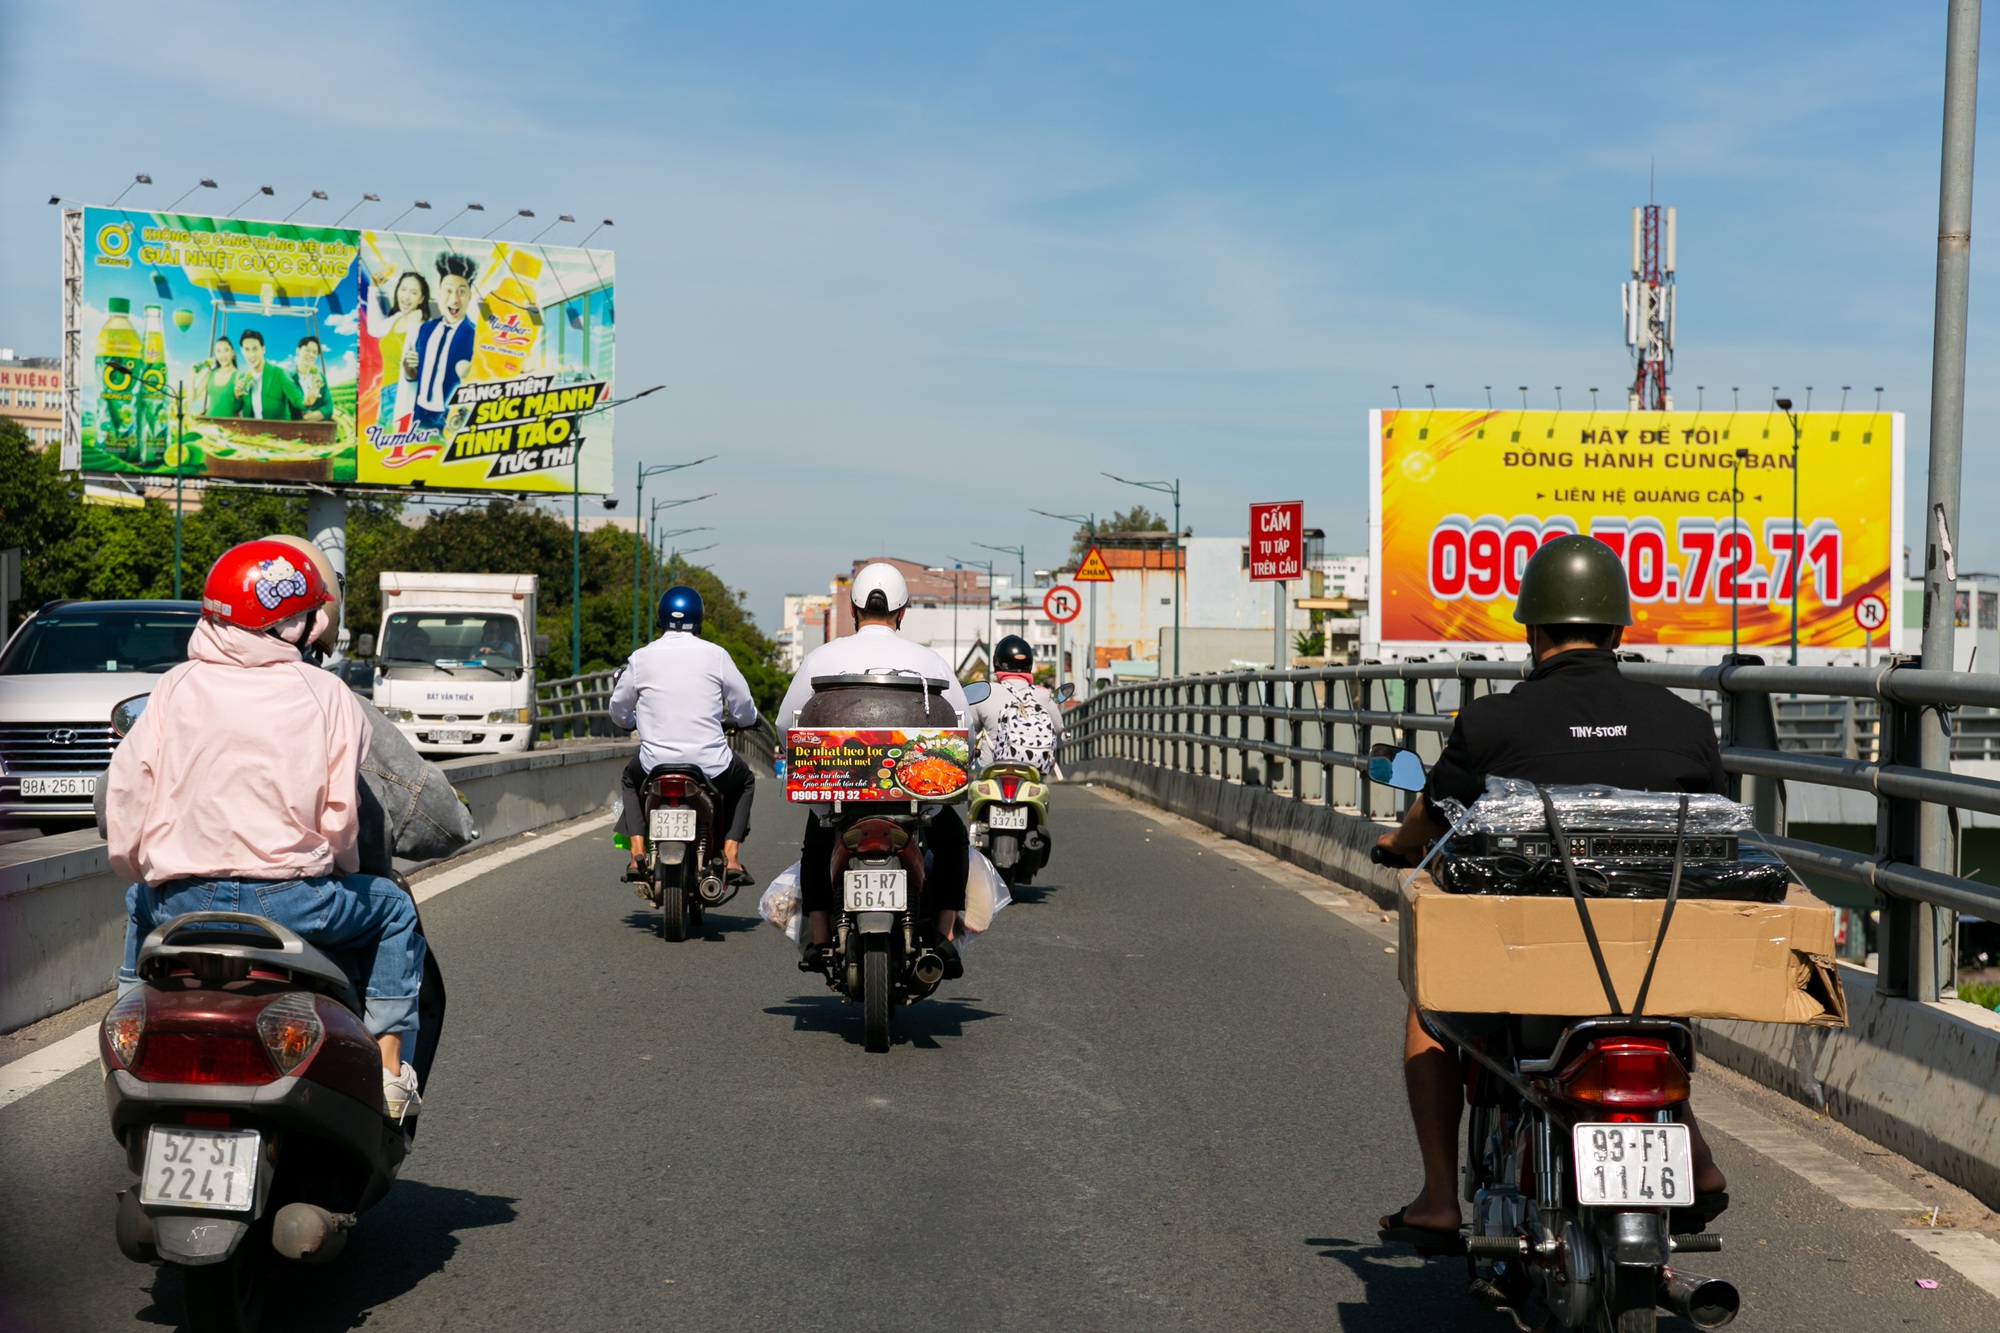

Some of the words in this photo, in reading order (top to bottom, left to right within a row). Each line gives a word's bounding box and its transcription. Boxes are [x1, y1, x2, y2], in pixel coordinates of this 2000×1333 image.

[143, 227, 190, 243] KHÔNG
[213, 231, 250, 249] CĂNG
[254, 232, 295, 253] THẲNG
[323, 240, 348, 256] MỎI
[141, 243, 180, 265] GIẢI
[185, 248, 234, 272] NHIỆT
[238, 252, 293, 276] CUỘC
[297, 254, 347, 278] SỐNG
[15, 372, 47, 388] VIỆN
[457, 383, 503, 403] TĂNG
[504, 377, 548, 398] THÊM
[475, 394, 521, 424] SỨC
[523, 386, 596, 417] MẠNH
[366, 422, 437, 449] Number
[455, 424, 513, 458] TỈNH
[516, 414, 571, 449] TÁO
[1581, 426, 1629, 445] HÃY
[1638, 424, 1670, 445] ĐỂ
[1681, 426, 1718, 445] TÔI
[499, 449, 538, 474] TỨC
[1503, 447, 1573, 468] ĐỒNG
[1584, 449, 1653, 468] HÀNH
[1664, 449, 1734, 469] CÙNG
[1744, 453, 1795, 473] BẠN
[1554, 487, 1595, 502] LIÊN
[1603, 487, 1626, 505] HỆ
[1633, 486, 1700, 503] QUẢNG
[1707, 487, 1744, 503] CÁO
[1260, 505, 1291, 533] CẤM
[1259, 540, 1271, 556] TỤ
[1273, 537, 1290, 555] TẬP
[1253, 561, 1276, 576] TRÊN
[1278, 556, 1298, 575] CẦU
[1569, 725, 1628, 738] TINY-STORY
[22, 779, 95, 794] 98A-256.10
[791, 790, 818, 800] 0906
[819, 790, 831, 800] 79
[833, 790, 845, 800] 79
[847, 790, 860, 800] 32
[656, 812, 689, 825] 52-F3
[992, 817, 1025, 827] 337.19
[656, 825, 689, 838] 3125
[853, 873, 897, 890] 51-R7
[853, 891, 896, 907] 6641
[163, 1131, 239, 1167] 52-S1
[1592, 1129, 1668, 1162] 93-F1
[158, 1166, 235, 1203] 2241
[1593, 1166, 1675, 1199] 1146
